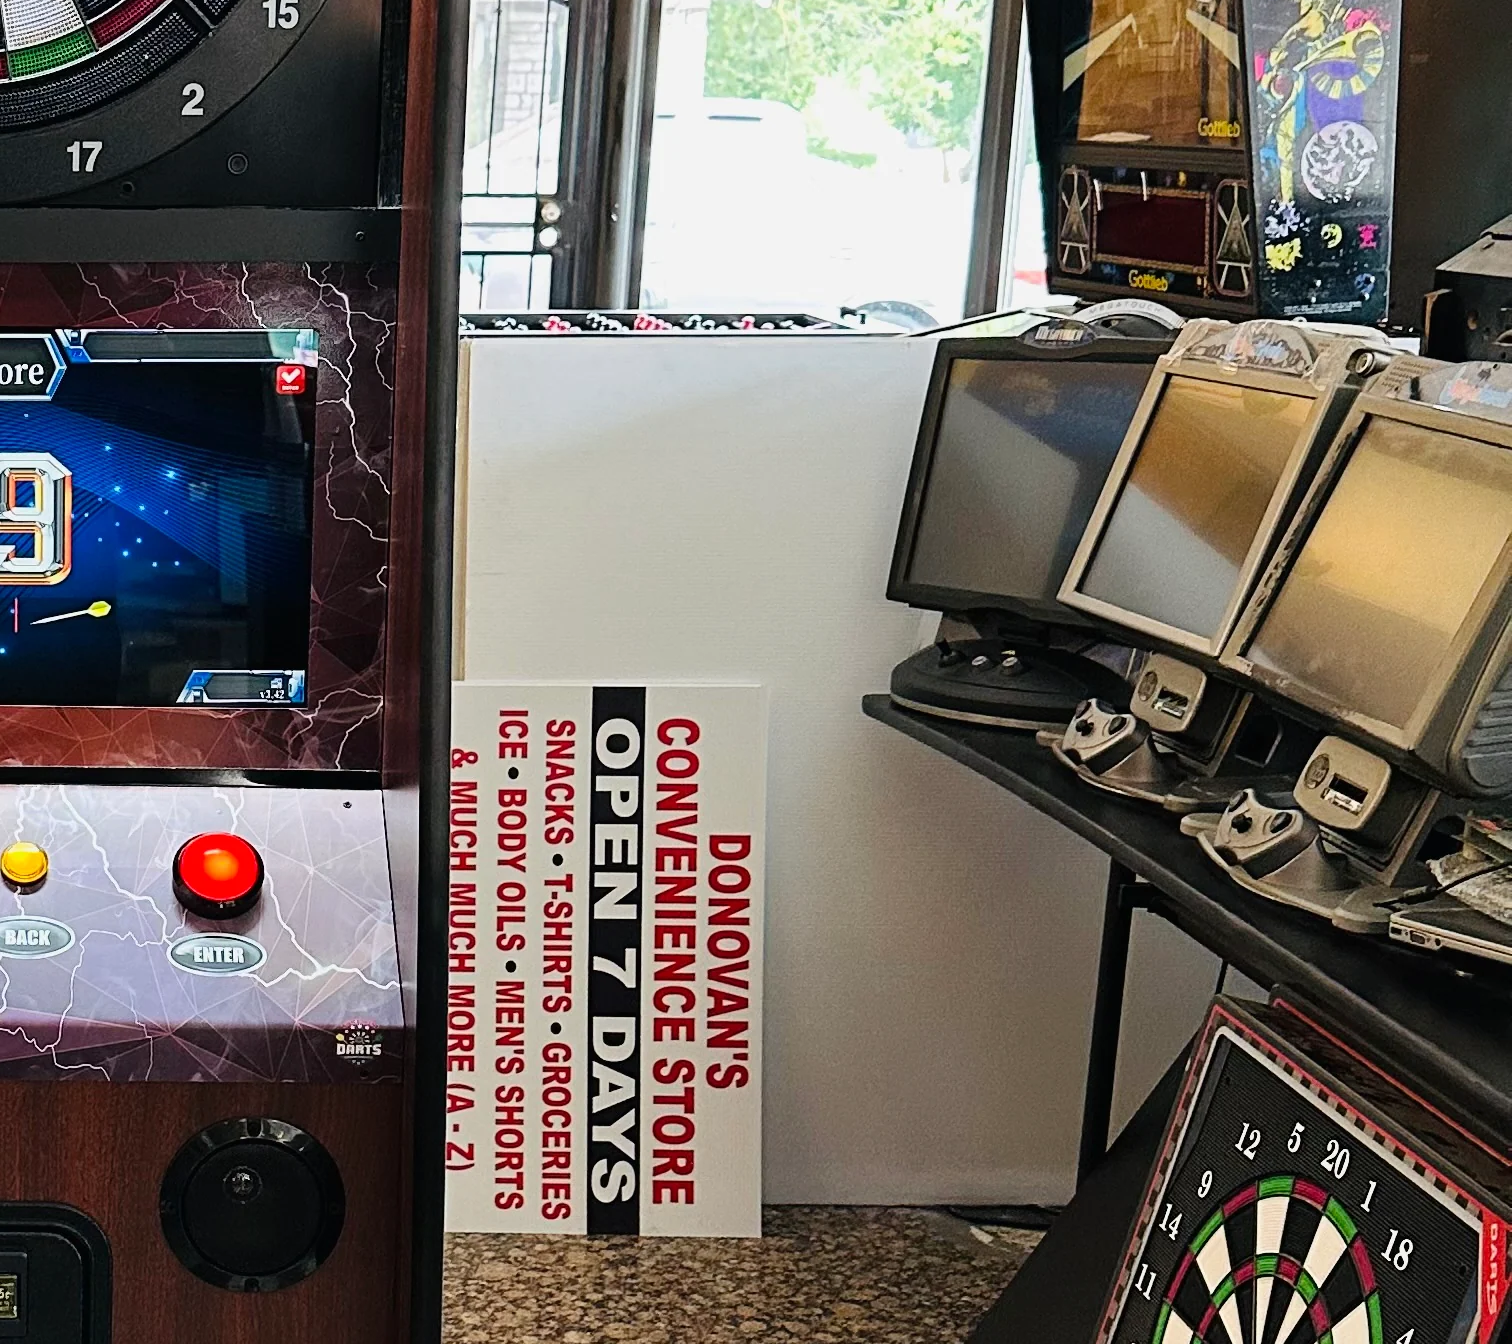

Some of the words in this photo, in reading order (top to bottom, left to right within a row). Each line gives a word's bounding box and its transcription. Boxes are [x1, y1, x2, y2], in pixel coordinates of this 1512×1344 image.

[181, 82, 205, 116] 2
[1198, 117, 1241, 139] Gottlieb
[66, 141, 103, 172] 17
[1128, 269, 1169, 292] Gottlieb
[496, 709, 530, 760] ICE
[450, 746, 480, 770] &
[543, 719, 577, 846] SNACKS
[448, 780, 479, 873] MUCH
[496, 787, 529, 873] BODY
[594, 718, 641, 921] OPEN
[654, 717, 700, 1043] CONVENIENCE
[4, 928, 51, 948] BACK
[448, 881, 478, 974] MUCH
[495, 880, 528, 953] OILS
[192, 944, 245, 964] ENTER
[541, 872, 576, 1014] T-SHIRTS
[705, 833, 753, 1089] DONOVAN'S
[592, 948, 637, 989] 7
[446, 983, 477, 1073] MORE
[494, 979, 527, 1076] MEN'S
[336, 1043, 382, 1056] DARTS
[540, 1041, 574, 1221] GROCERIES
[591, 1016, 636, 1204] DAYS
[650, 1057, 697, 1206] STORE
[493, 1084, 526, 1212] SHORTS
[1234, 1122, 1261, 1161] 12
[1287, 1121, 1306, 1153] 5
[1320, 1139, 1350, 1180] 20
[1197, 1170, 1213, 1199] 9
[1360, 1180, 1377, 1213] 1
[1159, 1205, 1181, 1240] 14
[1380, 1228, 1414, 1271] 18
[1135, 1263, 1156, 1300] 11
